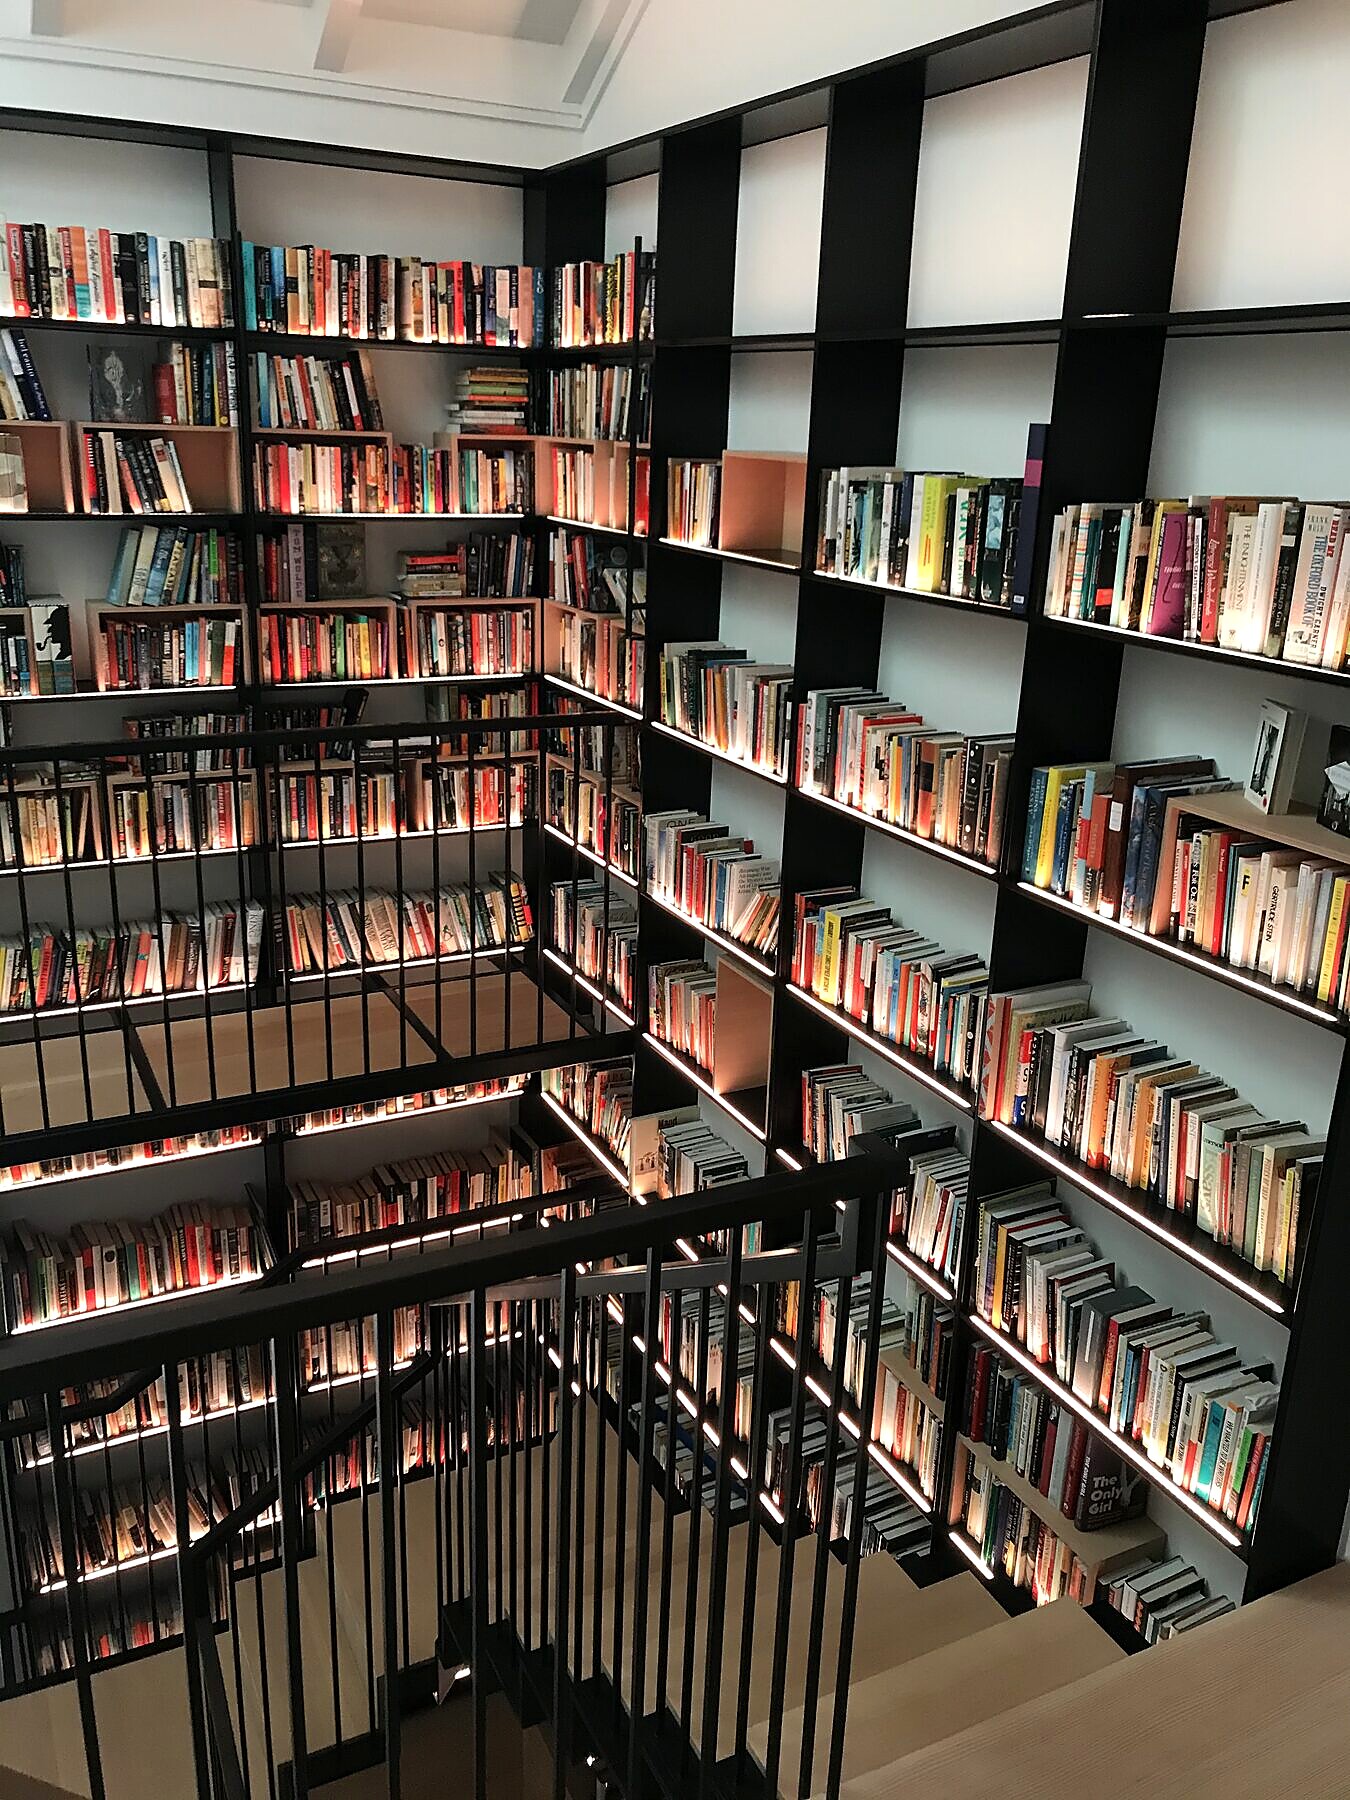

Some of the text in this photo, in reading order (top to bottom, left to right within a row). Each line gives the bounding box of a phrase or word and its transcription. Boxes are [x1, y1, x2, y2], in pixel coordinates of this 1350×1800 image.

[1329, 520, 1338, 543] READ
[1235, 524, 1252, 612] THE ENLIGHTENMENT
[1301, 535, 1327, 627] THE OXFORD BOOK OF
[1311, 586, 1327, 649] DWIGHT GARNER
[1242, 874, 1250, 890] F
[1265, 885, 1279, 943] GERTRUDE STEIN
[247, 913, 259, 935] KING
[1169, 1425, 1177, 1438] Story
[1226, 1420, 1234, 1430] WE
[1222, 1431, 1233, 1452] WANTED
[1219, 1458, 1226, 1466] BE
[1082, 1467, 1090, 1483] ONLY
[1093, 1476, 1117, 1488] The
[1216, 1465, 1226, 1488] WRITERS
[1091, 1487, 1122, 1501] Only
[1089, 1500, 1112, 1514] Girl
